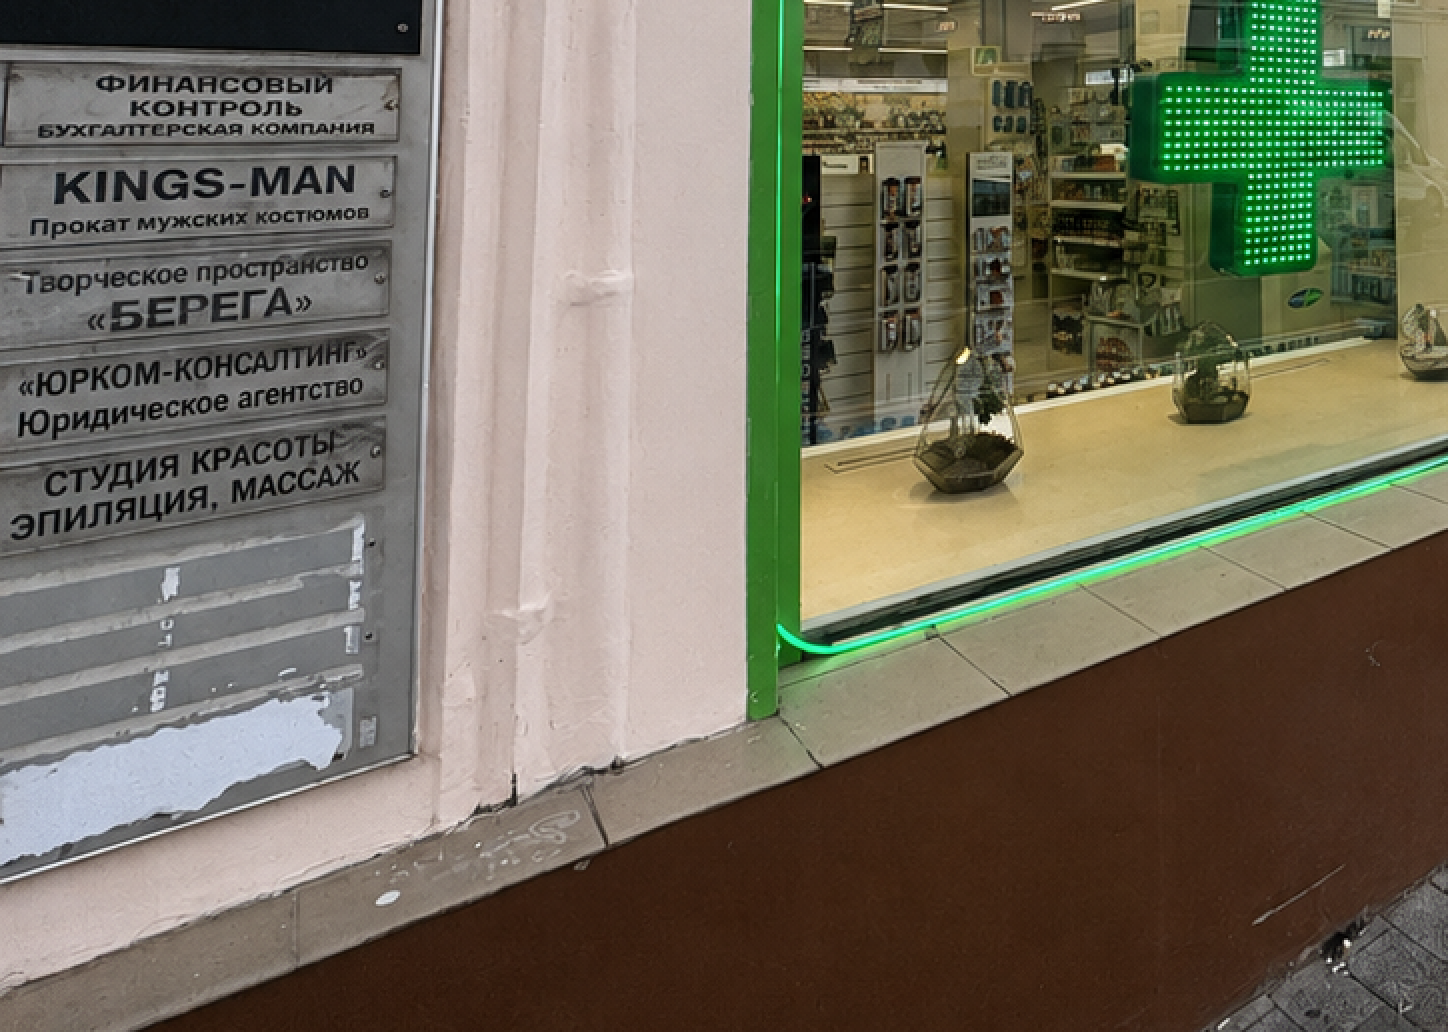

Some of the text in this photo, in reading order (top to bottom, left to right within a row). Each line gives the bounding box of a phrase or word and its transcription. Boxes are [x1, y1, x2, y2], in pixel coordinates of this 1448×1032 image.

[96, 73, 333, 94] ФИНАНСОВЫЙ
[129, 100, 303, 117] КОНТРОЛЬ
[37, 122, 375, 139] БУХГАЛТЕРСКАЯ КОМПАНИЯ
[54, 165, 355, 204] KINGS-MAN
[30, 207, 370, 240] Прокат мужских костюмов
[23, 255, 369, 296] Творческое пространство
[87, 287, 312, 332] «БЕРЕГА»
[19, 342, 367, 397] «ЮРКОМ-КОНСАЛТИНГ»
[18, 378, 363, 440] Юридическое агентство
[45, 429, 336, 496] СТУДИЯ КРАСОТЫ
[10, 460, 361, 540] ЭПИЛЯЦИЯ, МАССАЖ
